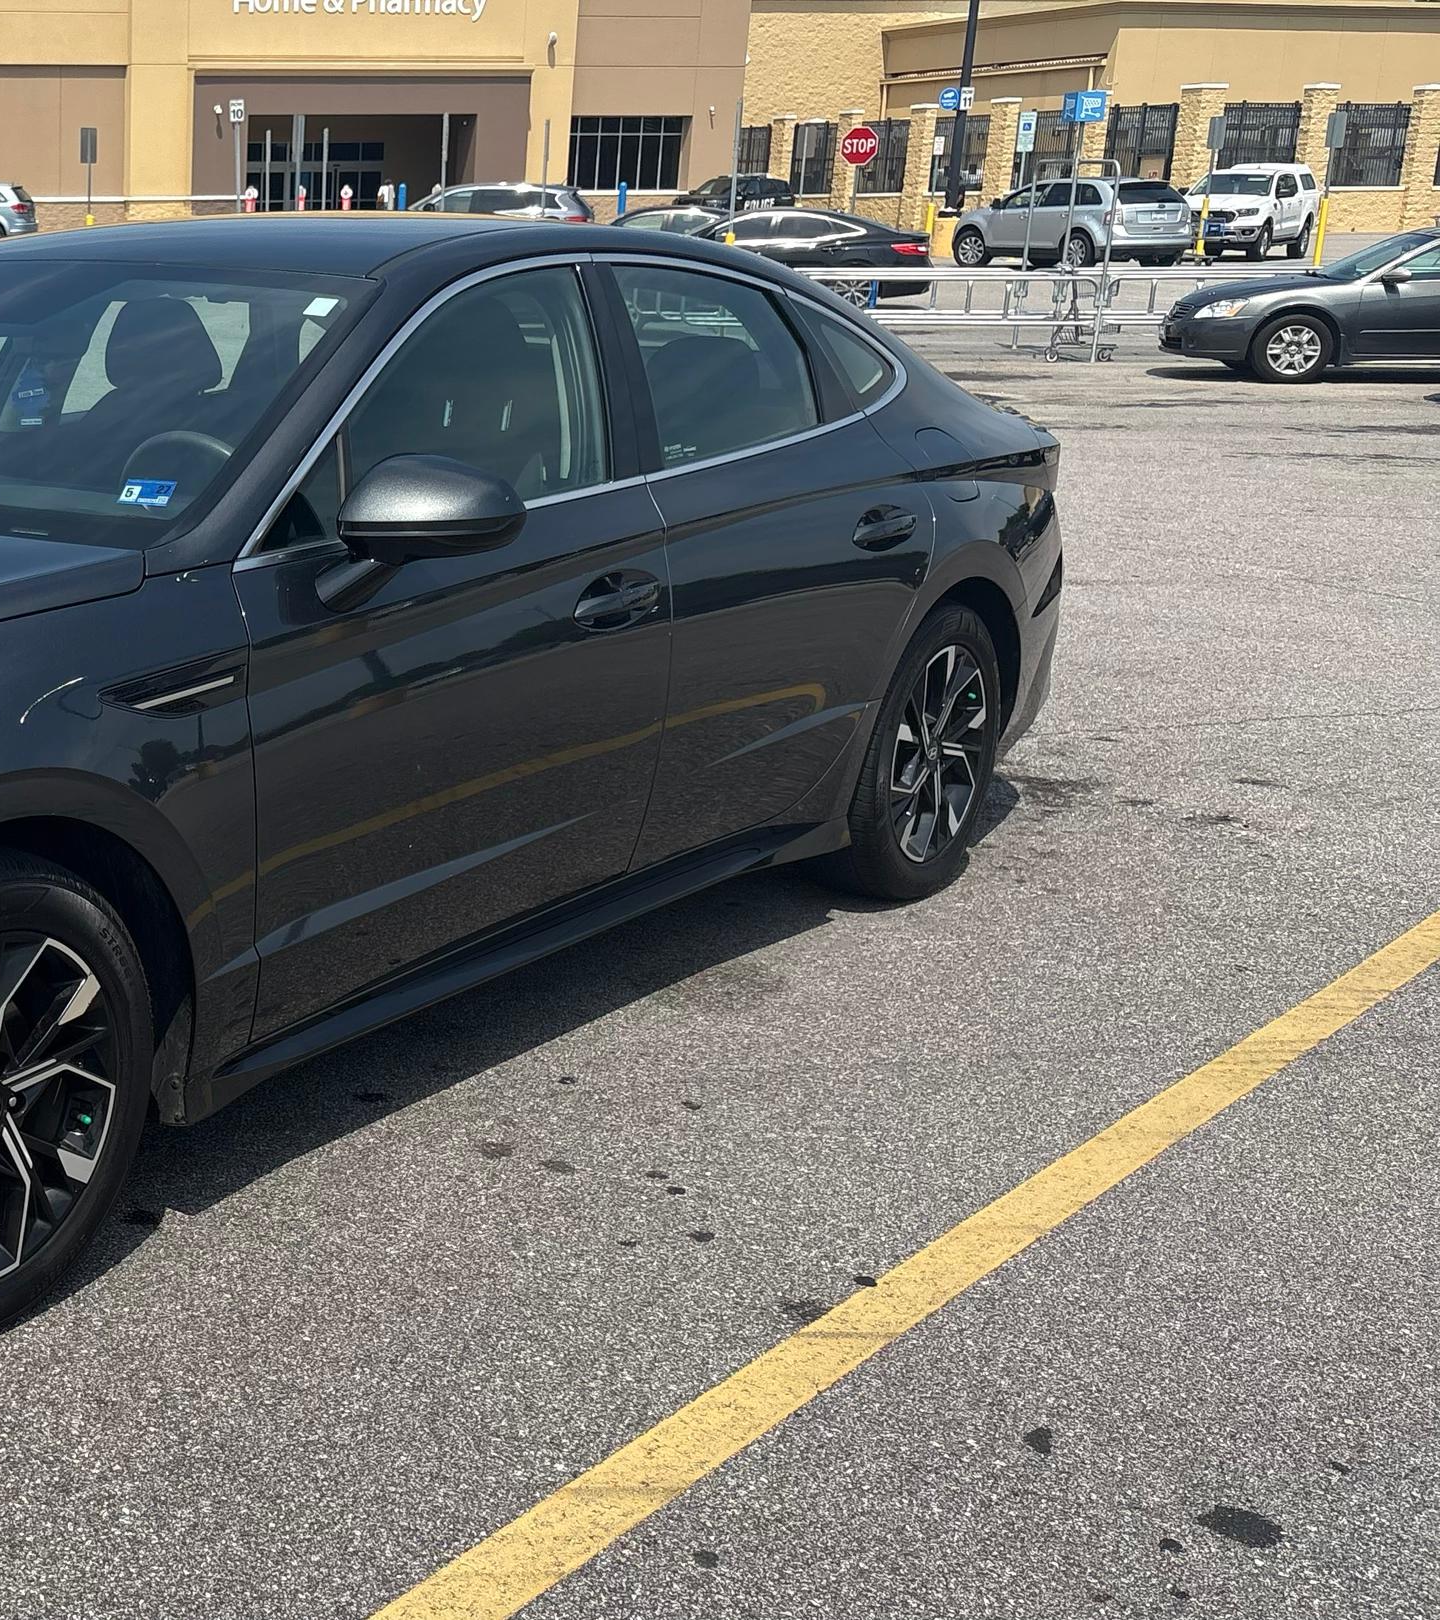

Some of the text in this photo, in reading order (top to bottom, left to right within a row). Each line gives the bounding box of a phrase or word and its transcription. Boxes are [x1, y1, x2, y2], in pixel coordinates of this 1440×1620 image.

[962, 96, 972, 107] 11
[231, 108, 243, 119] 10
[843, 138, 875, 154] STOP
[744, 198, 775, 210] POLICE
[125, 488, 134, 498] 5
[156, 485, 171, 495] 27
